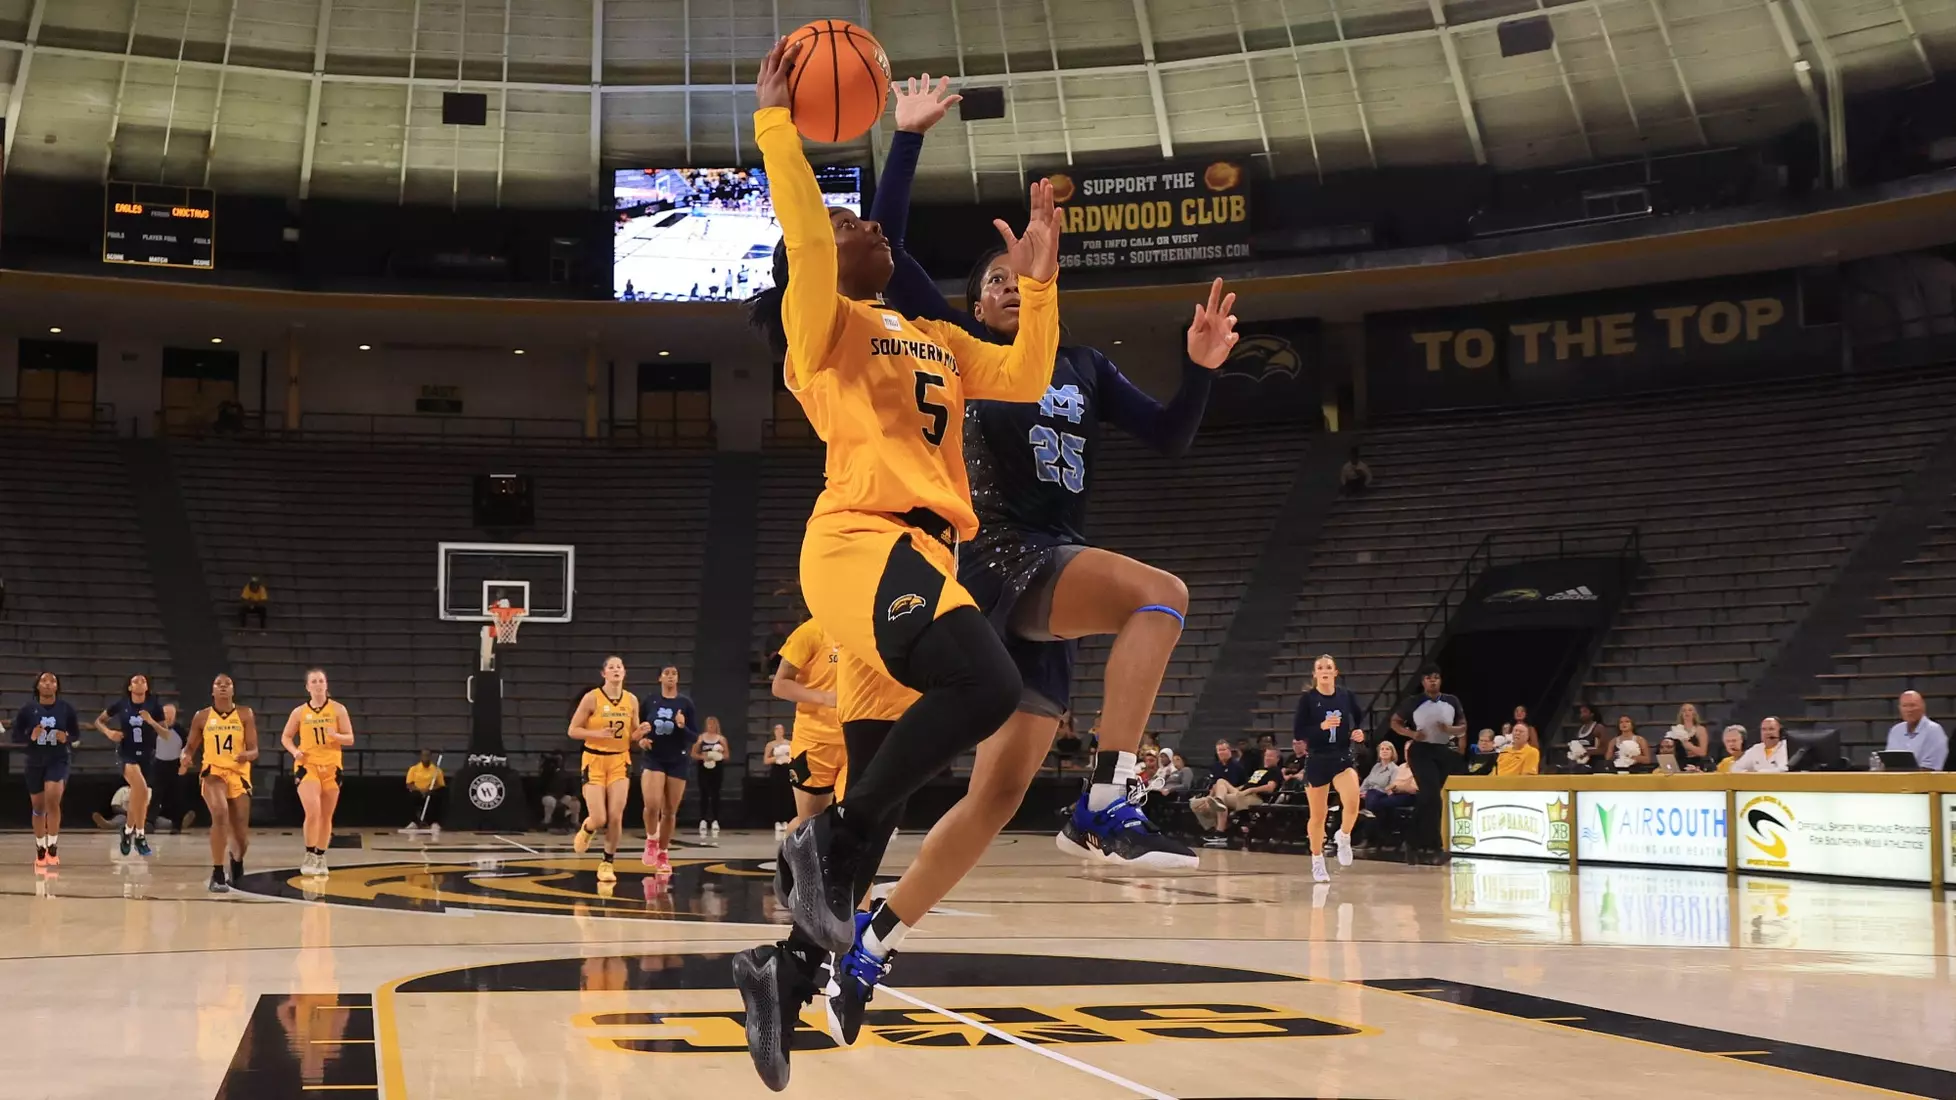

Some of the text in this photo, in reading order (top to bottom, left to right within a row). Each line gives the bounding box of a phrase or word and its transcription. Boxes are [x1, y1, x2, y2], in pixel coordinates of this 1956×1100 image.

[1083, 172, 1195, 196] SUPPORT THE
[114, 203, 143, 214] EAGLES
[171, 207, 210, 219] CHOCTAWS
[1058, 195, 1246, 233] ARDWOOD CLUB
[1083, 234, 1199, 250] FOR INFO CALL OR VISIT
[1129, 243, 1250, 264] SOUTHERNMISS.COM
[1412, 297, 1784, 372] TO THE TOP
[870, 338, 943, 362] SOUTHERN
[912, 369, 951, 447] 5
[1028, 424, 1087, 494] 25
[313, 726, 326, 745] 11
[609, 720, 625, 739] 12
[215, 734, 233, 755] 14
[1810, 835, 1823, 843] FOR
